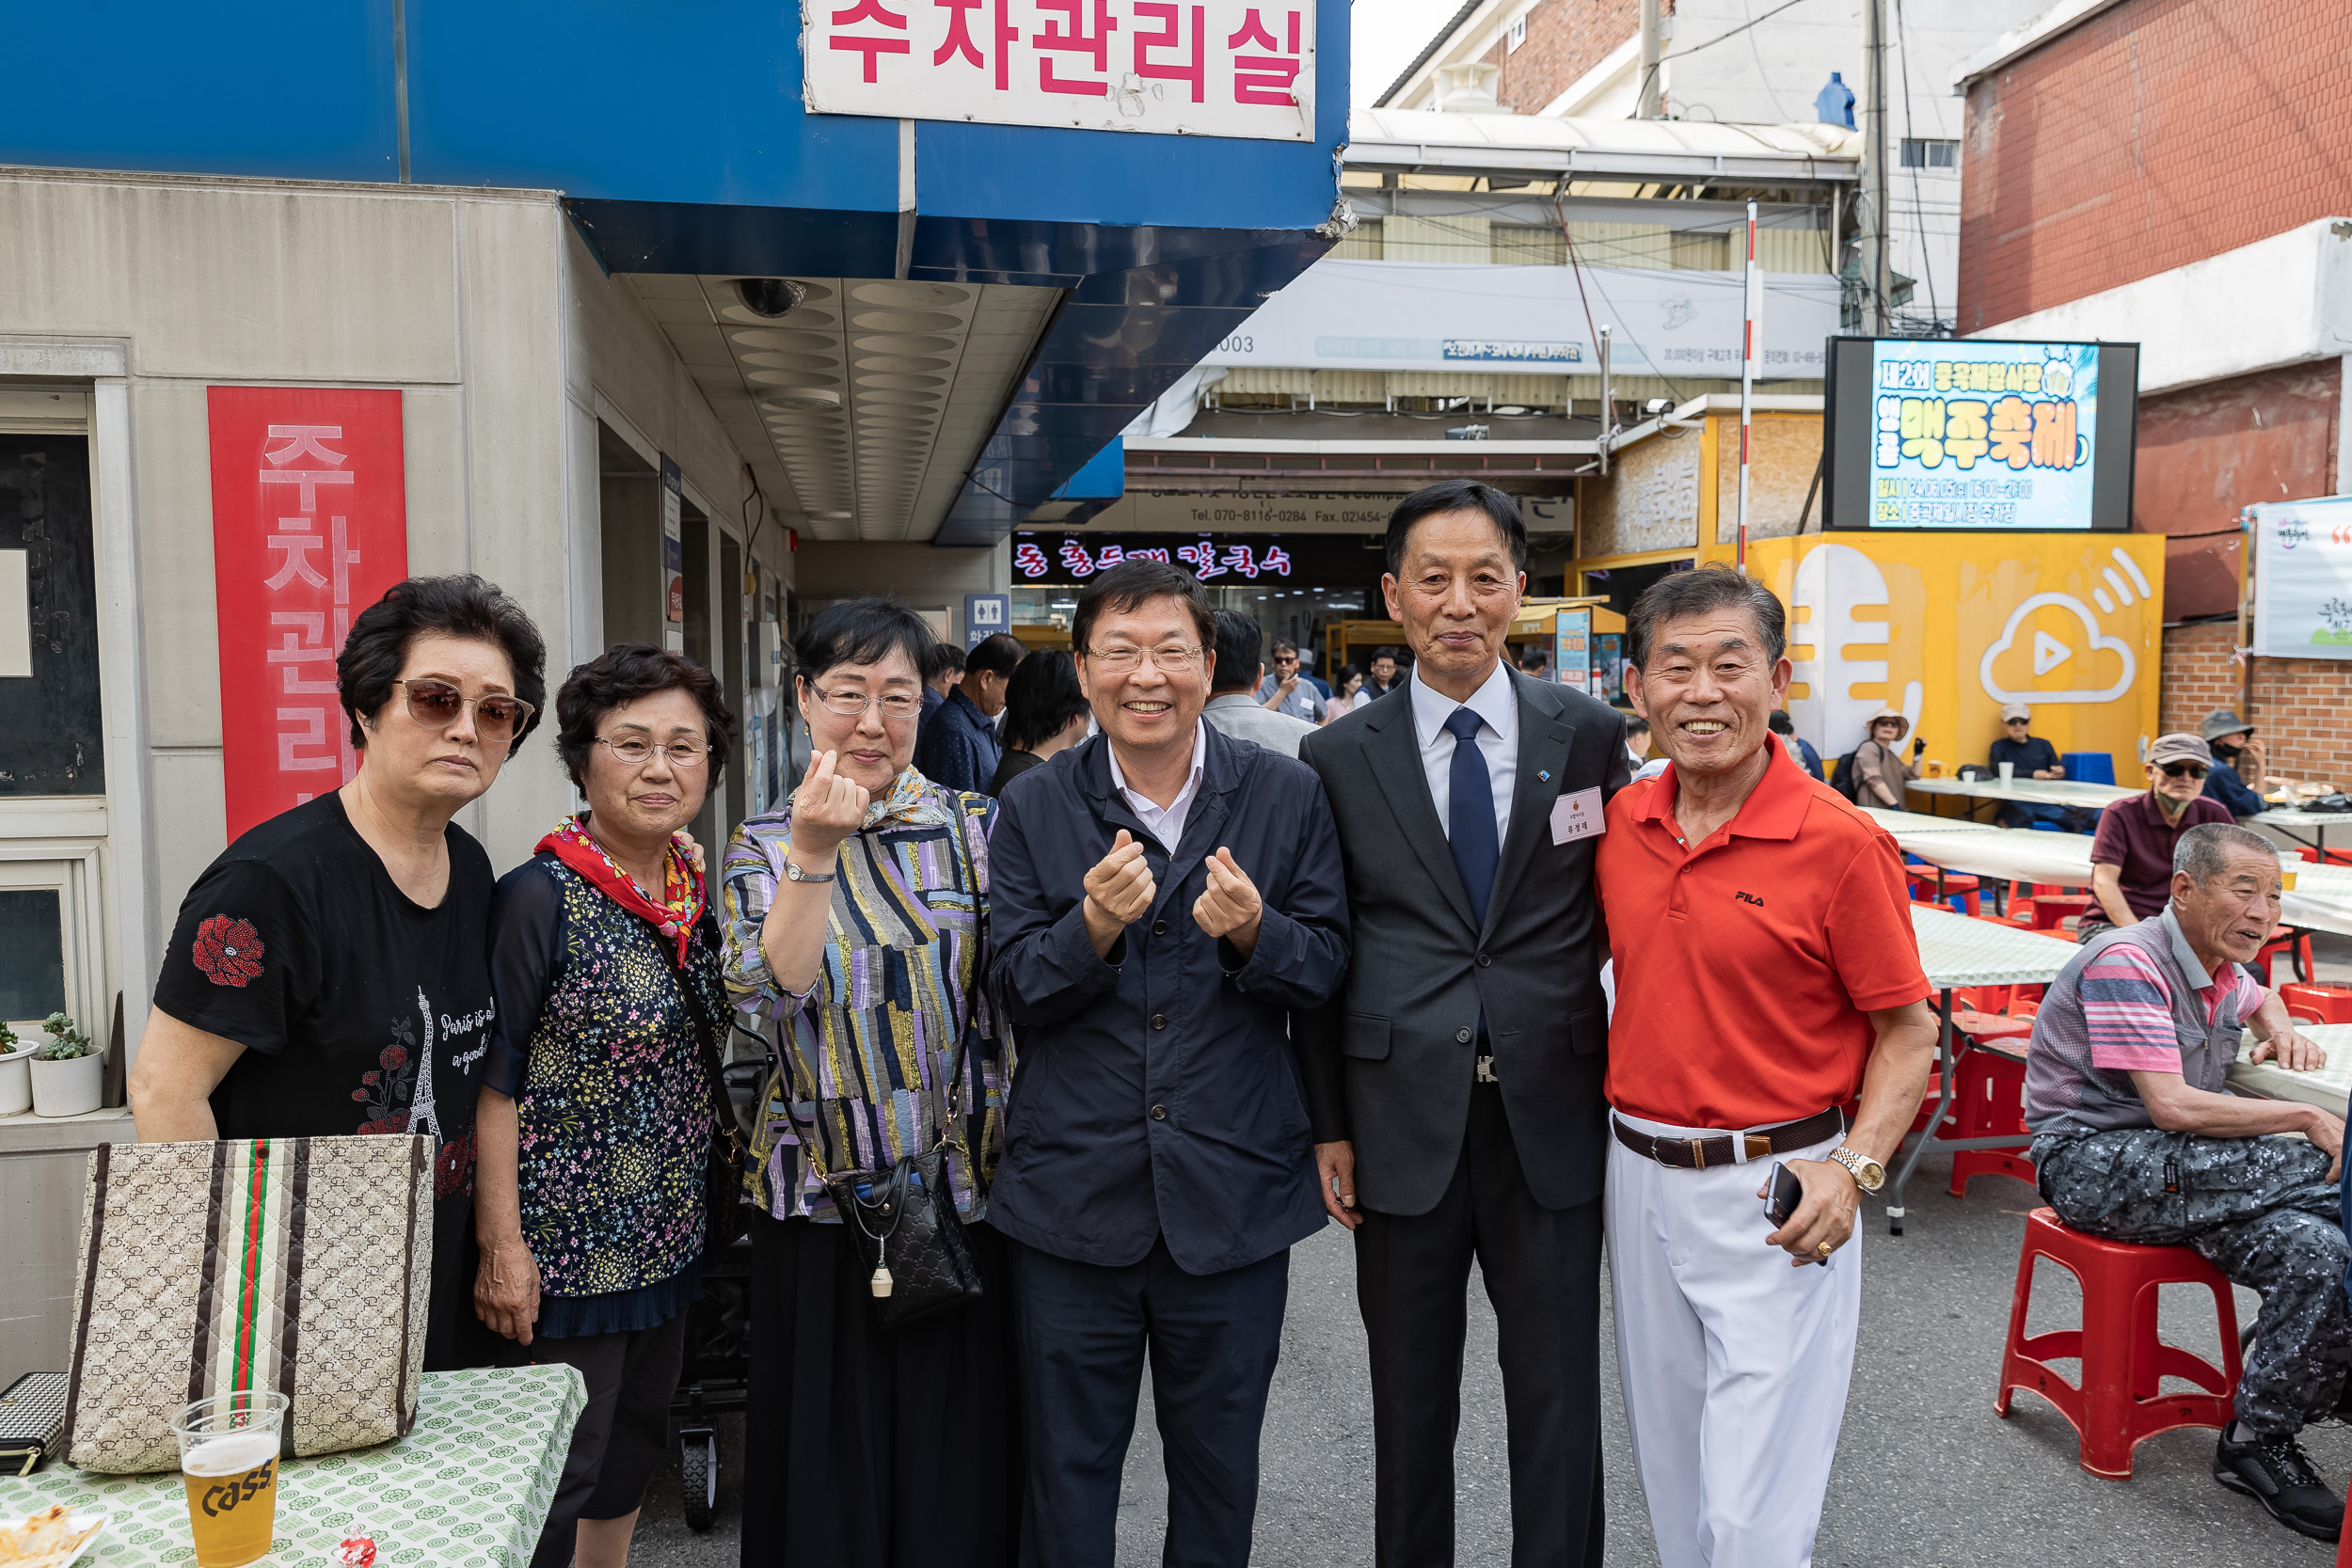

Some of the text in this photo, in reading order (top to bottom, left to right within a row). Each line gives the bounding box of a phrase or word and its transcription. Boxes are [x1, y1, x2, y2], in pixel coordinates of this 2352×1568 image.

[829, 0, 1300, 107] 주차관리실
[1213, 335, 1254, 354] 003
[1881, 360, 2043, 393] 제2회 중곡제일시장
[1900, 395, 2077, 470] 맥주축제
[1177, 541, 1291, 580] 칼국수
[259, 424, 361, 806] 주차관리
[1734, 890, 1765, 908] FILA
[440, 1013, 474, 1041] Paris
